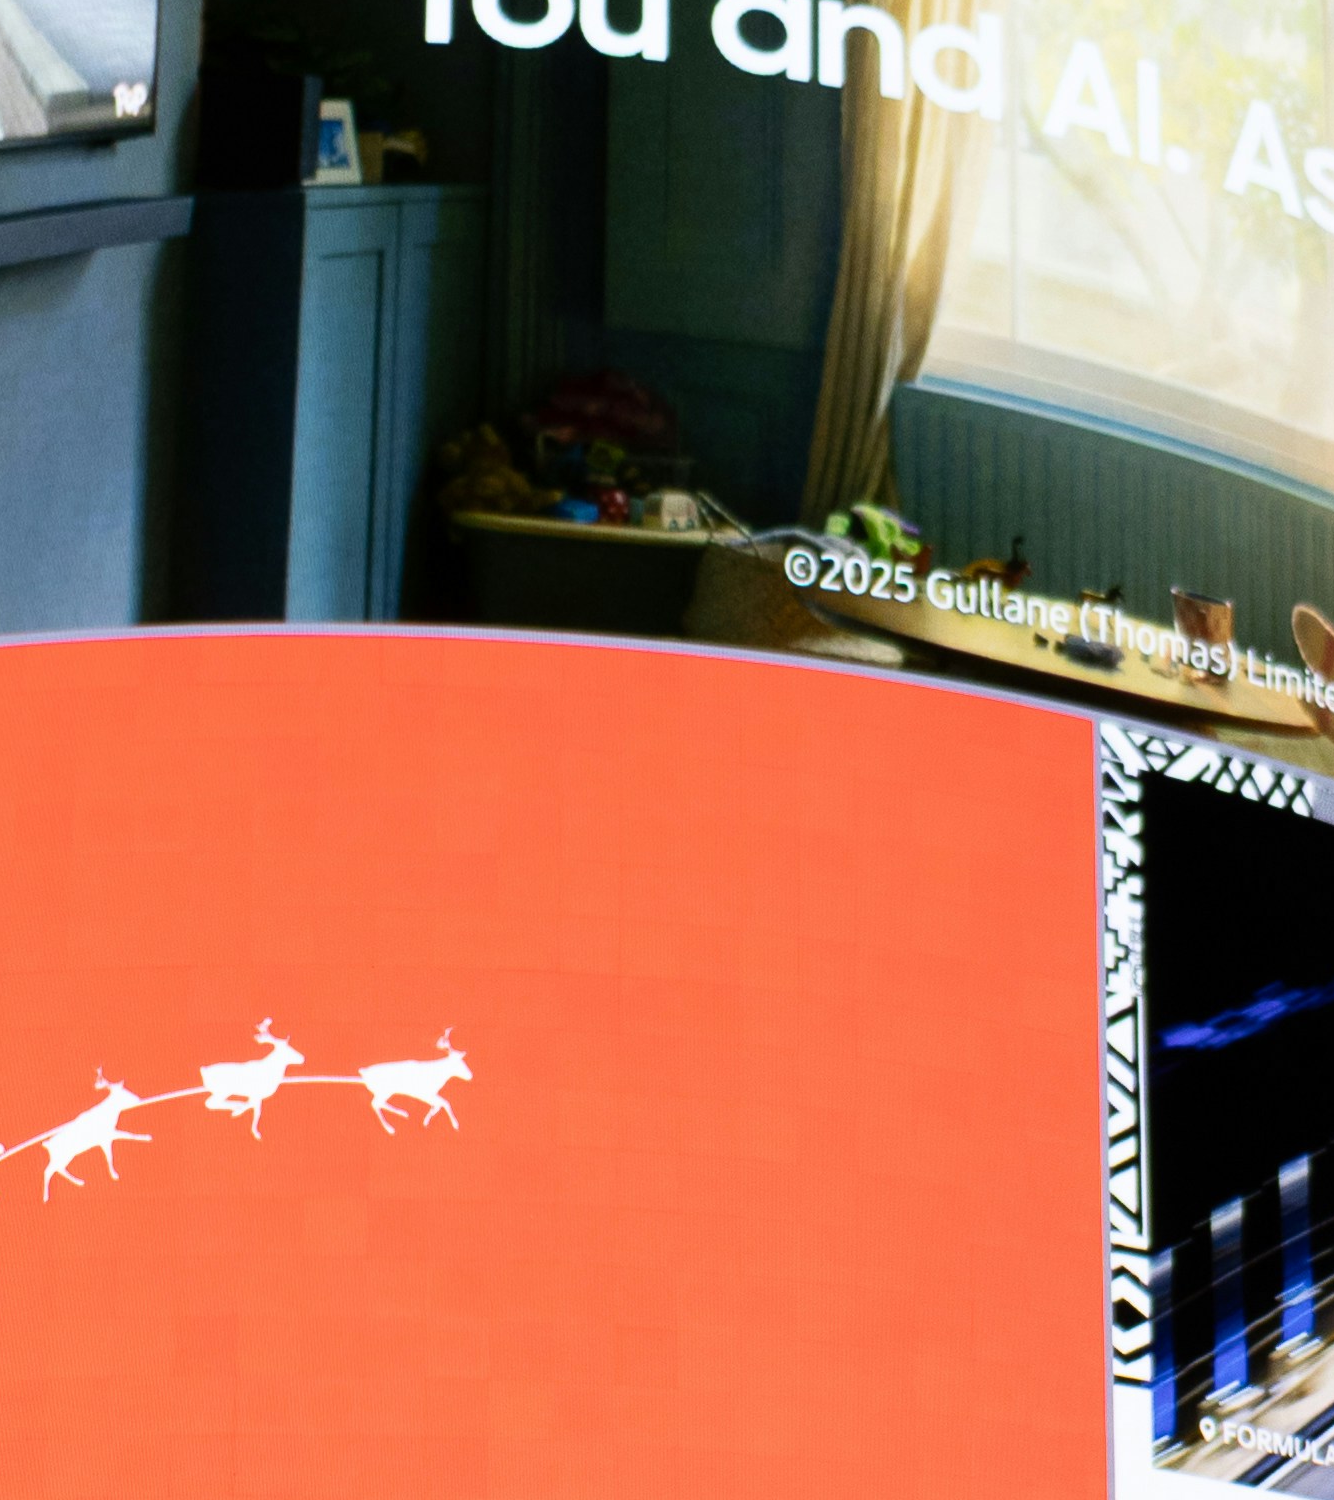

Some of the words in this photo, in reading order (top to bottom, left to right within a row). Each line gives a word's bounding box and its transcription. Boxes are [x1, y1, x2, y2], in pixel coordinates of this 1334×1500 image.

[1043, 39, 1192, 175] AI.
[784, 548, 916, 603] ©2025
[926, 572, 1069, 635] Gullane
[1079, 604, 1239, 683] (Thomas)
